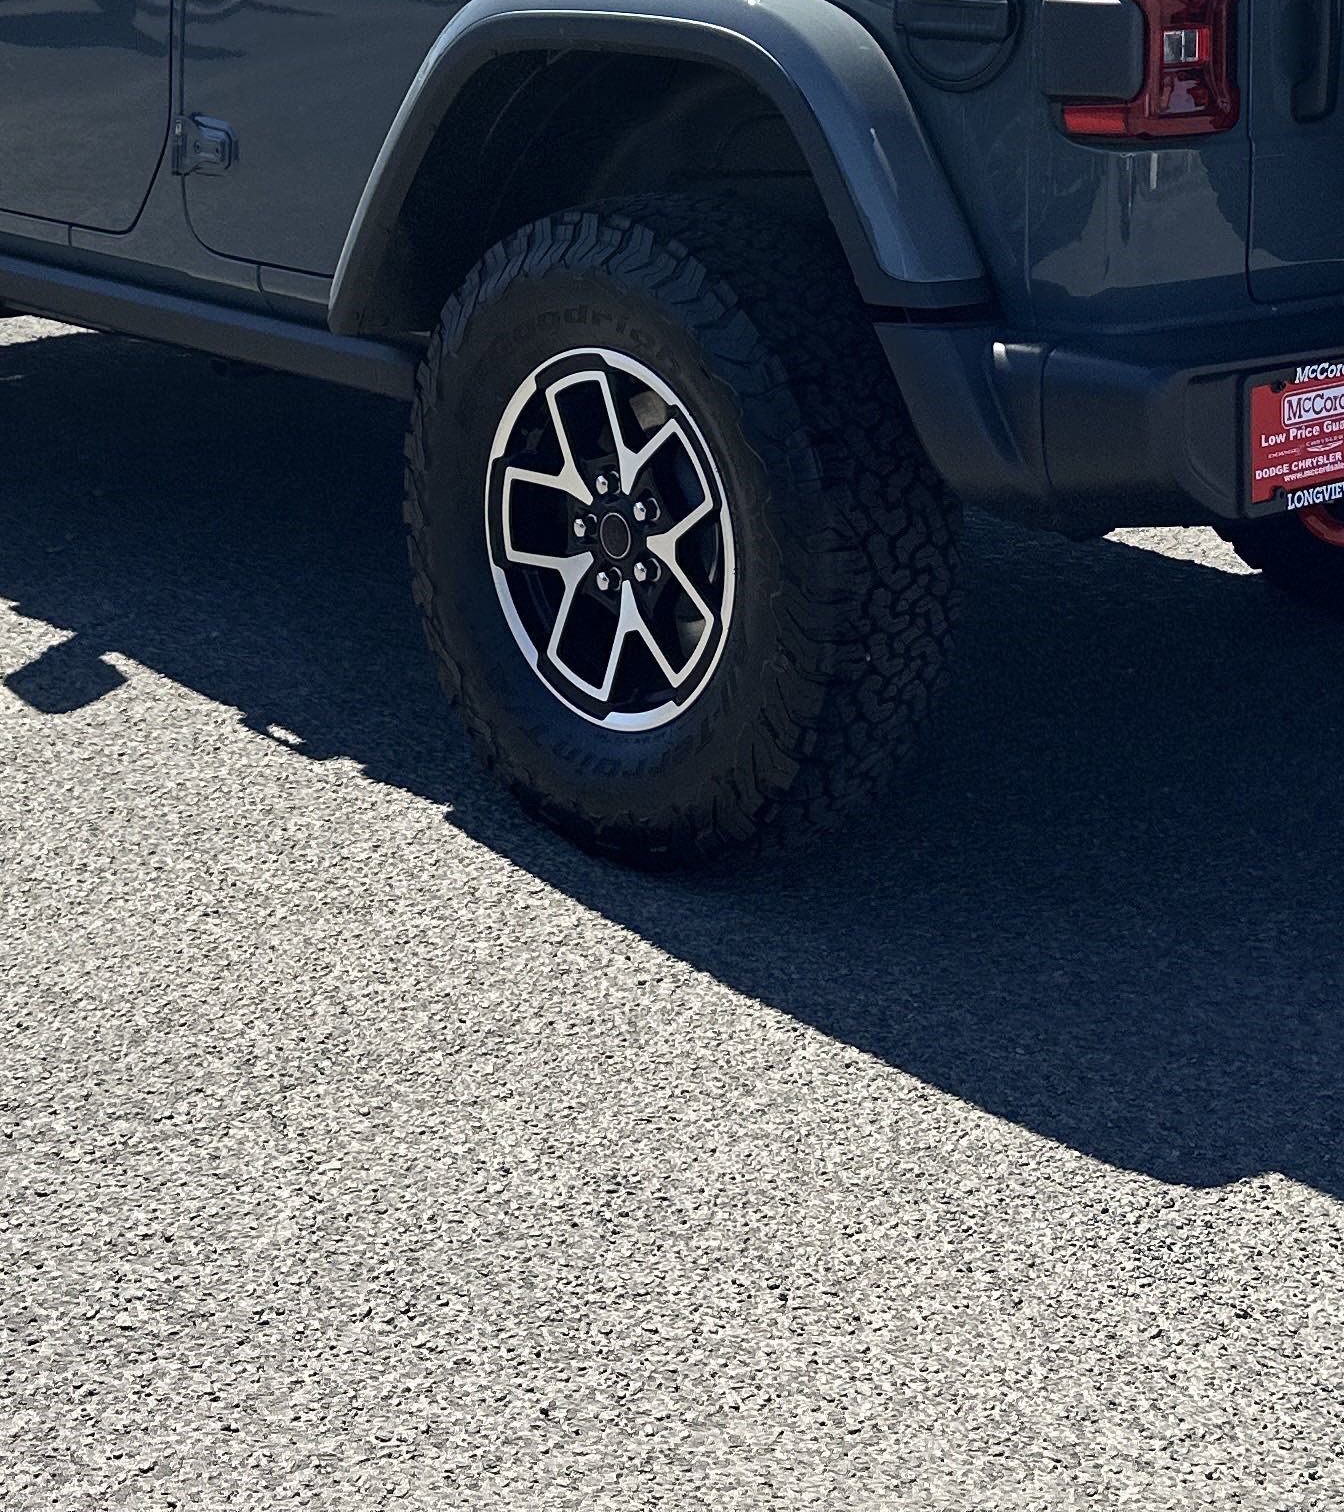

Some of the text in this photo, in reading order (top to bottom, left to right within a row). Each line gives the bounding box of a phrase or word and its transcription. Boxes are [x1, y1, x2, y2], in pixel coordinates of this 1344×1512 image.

[1261, 434, 1286, 447] Low
[1289, 425, 1320, 441] Price
[1255, 463, 1289, 480] DODGE
[1291, 452, 1342, 471] CHRYSLER
